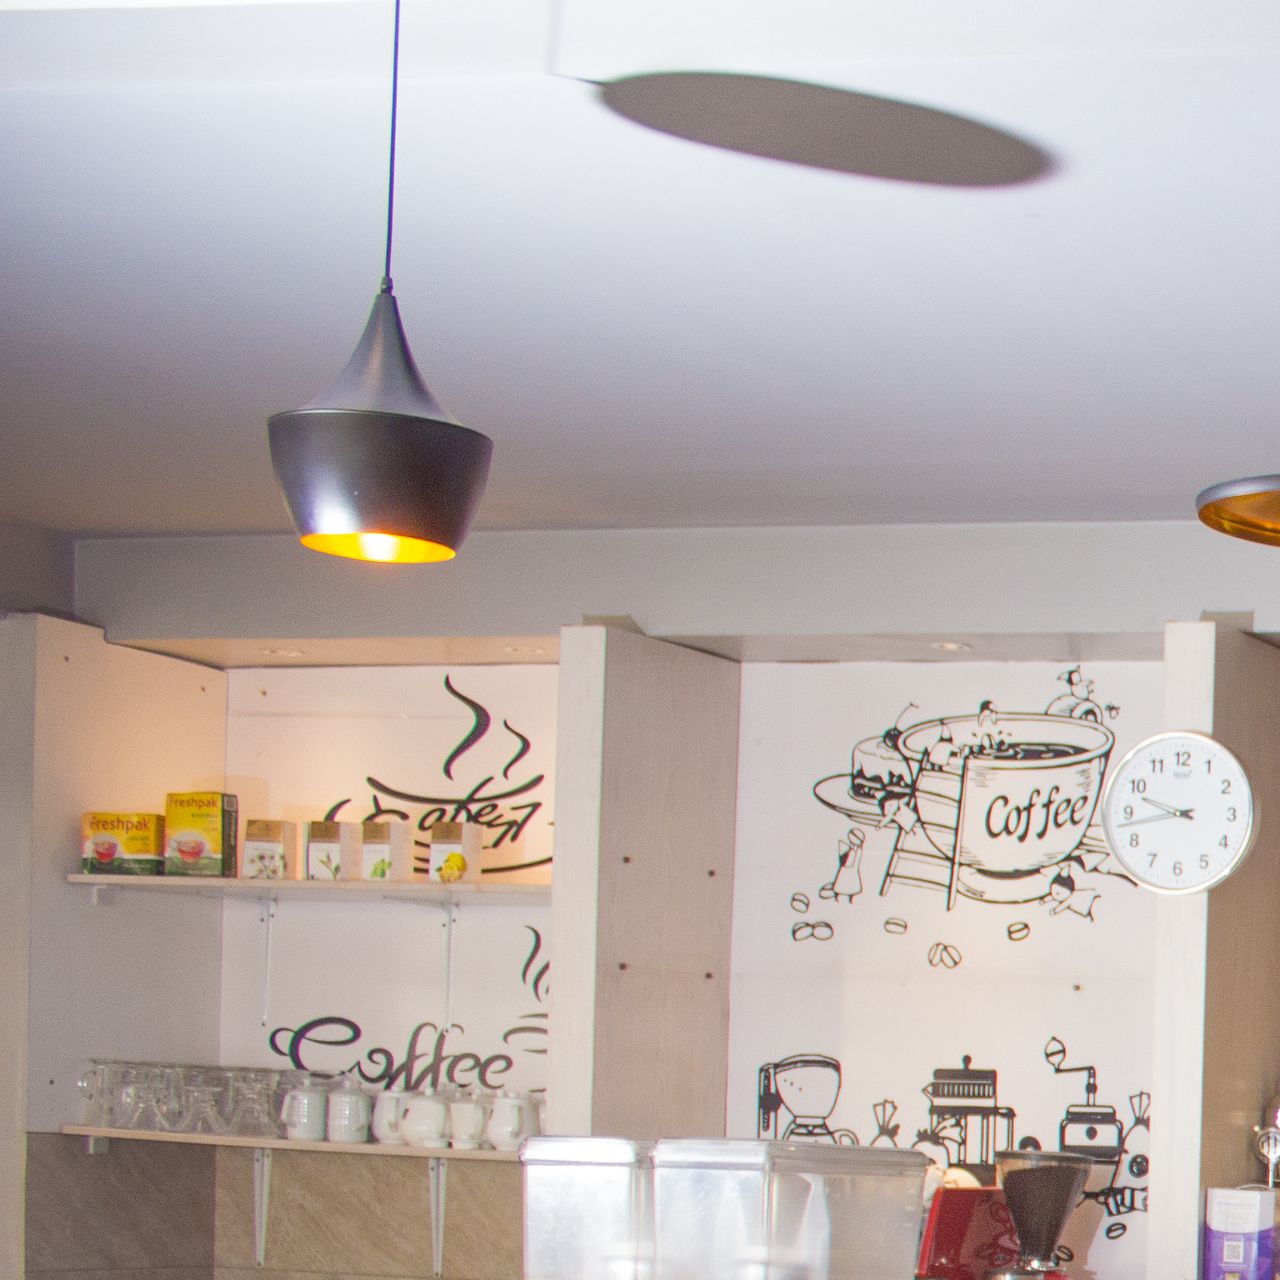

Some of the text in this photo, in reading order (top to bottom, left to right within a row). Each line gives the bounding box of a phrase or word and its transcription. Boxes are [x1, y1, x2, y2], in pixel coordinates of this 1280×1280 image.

[1151, 759, 1164, 773] 11
[1174, 751, 1191, 767] 12
[1205, 760, 1212, 773] 1
[1131, 779, 1146, 794] 10
[1220, 779, 1231, 794] 2
[984, 785, 1089, 843] Coffee
[1123, 805, 1134, 820] 9
[1227, 807, 1237, 822] 3
[1129, 833, 1139, 848] 8
[1218, 835, 1229, 849] 4
[1147, 854, 1158, 868] 7
[1172, 861, 1183, 876] 6
[1199, 854, 1209, 869] 5
[268, 1016, 513, 1091] Coffee
